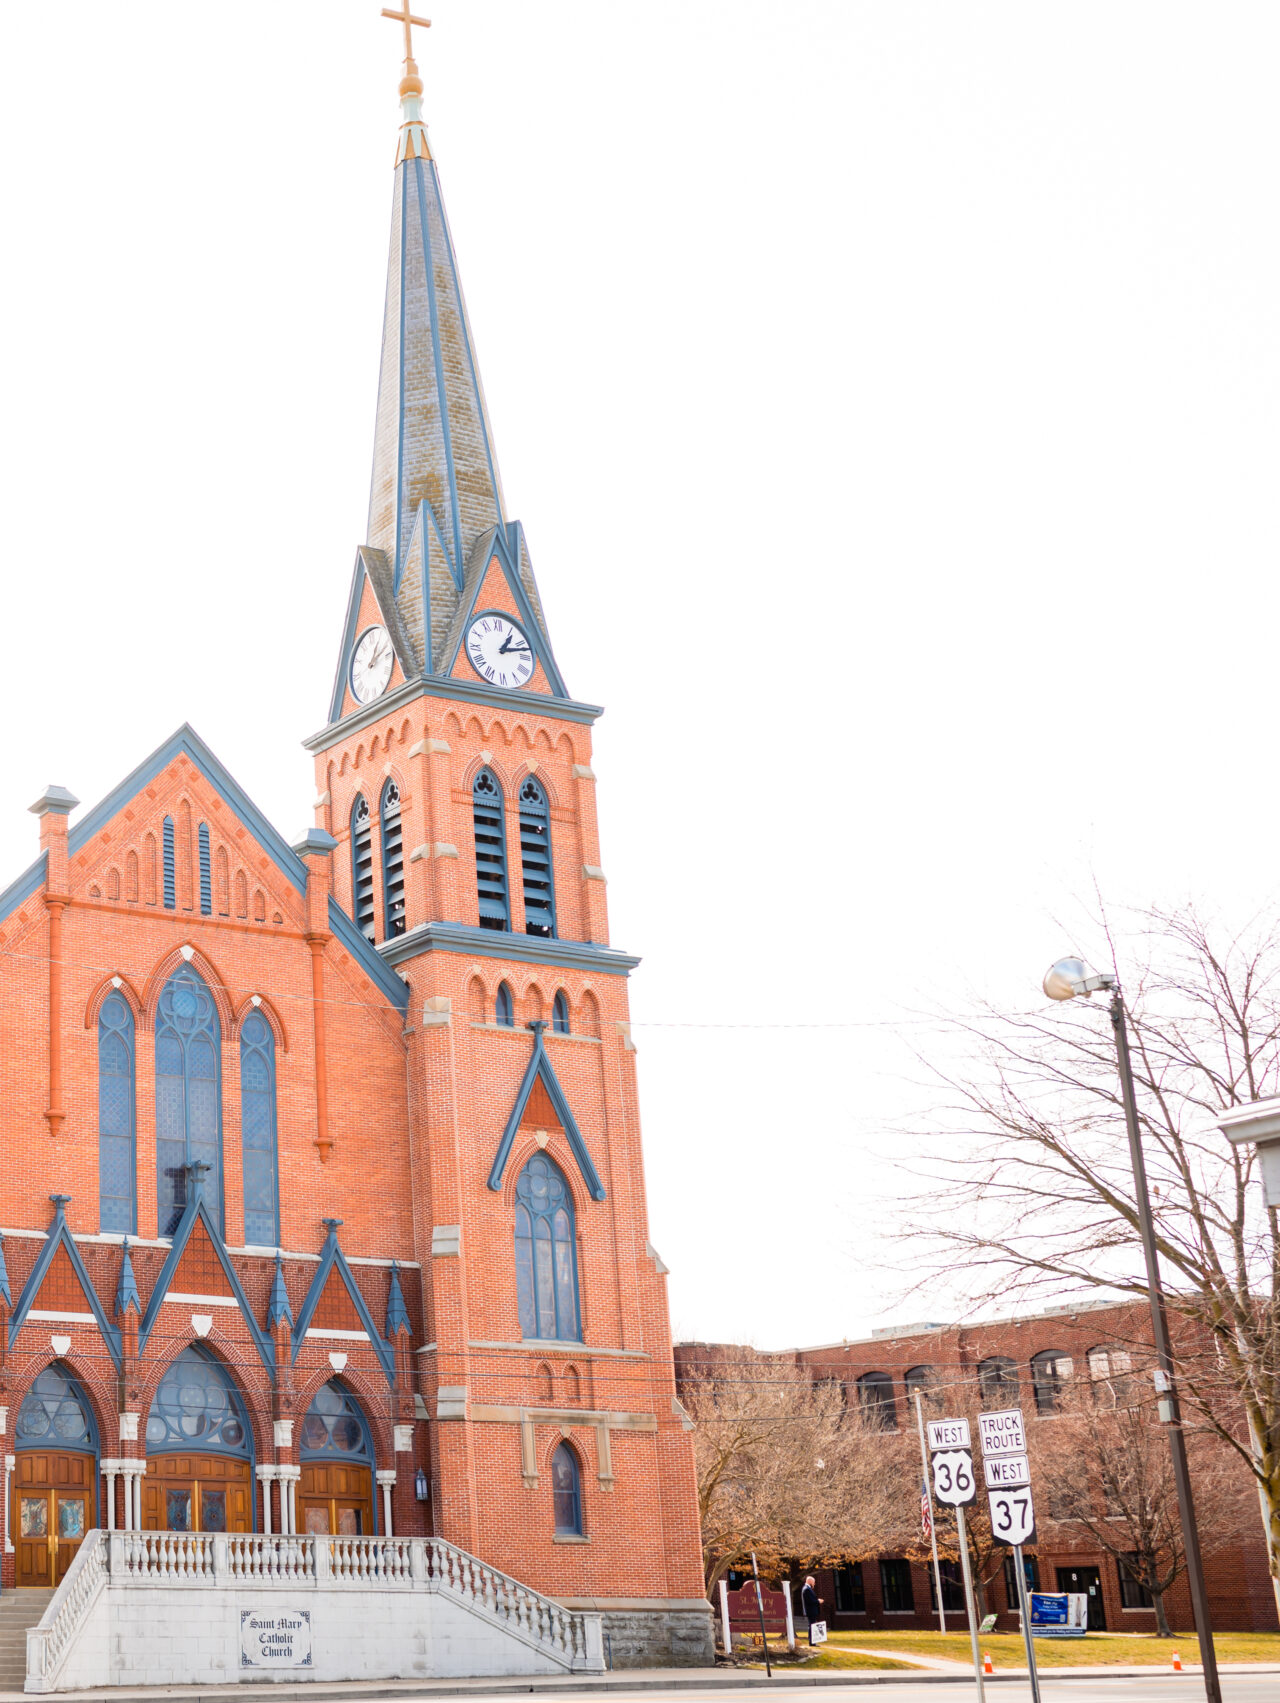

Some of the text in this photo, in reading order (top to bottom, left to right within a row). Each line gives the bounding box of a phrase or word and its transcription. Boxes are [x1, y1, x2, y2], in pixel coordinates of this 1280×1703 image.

[982, 1416, 1019, 1432] TRUCK
[933, 1426, 963, 1444] WEST
[986, 1433, 1022, 1449] ROUTE
[938, 1463, 970, 1492] 36
[991, 1463, 1022, 1481] WEST
[996, 1498, 1028, 1531] 37
[249, 1617, 302, 1631] Saint Mary
[259, 1633, 293, 1644] Catholic
[261, 1645, 292, 1657] Church
